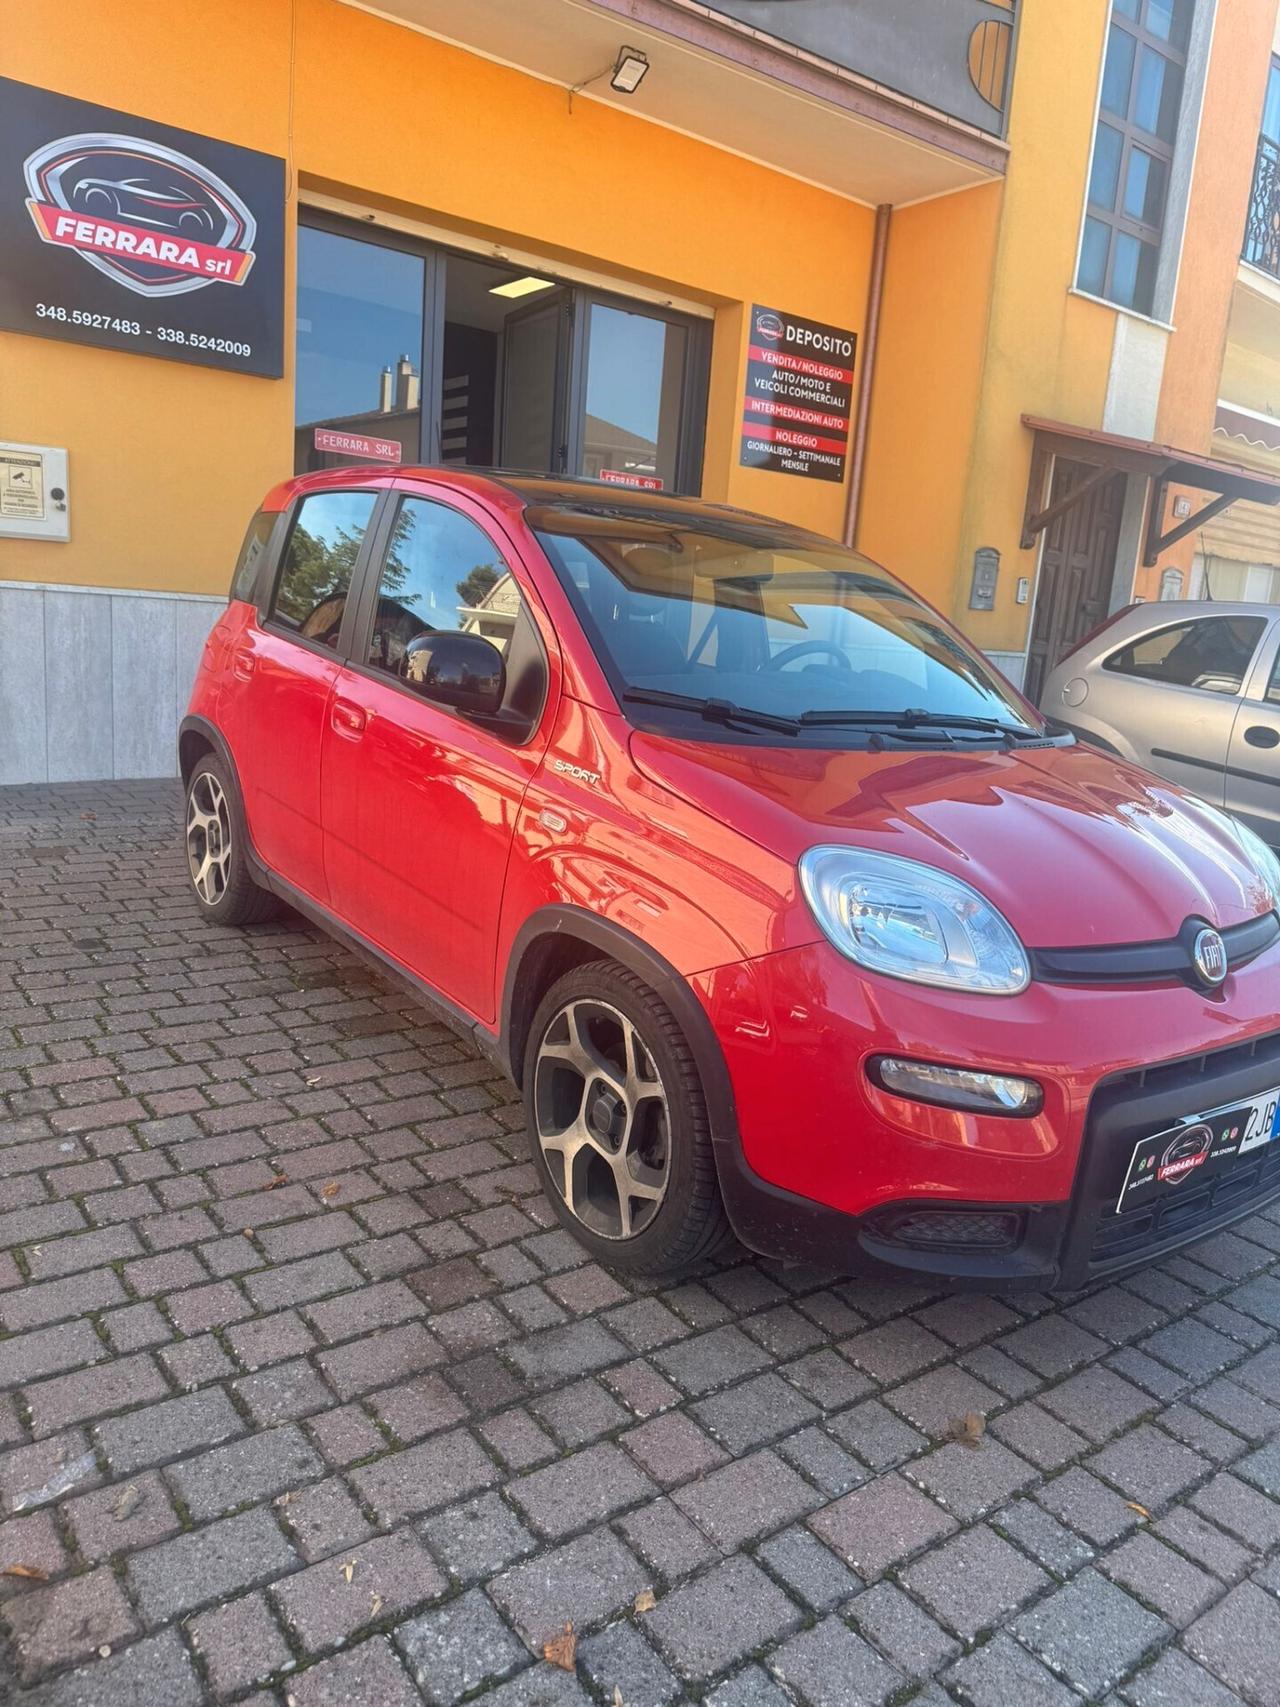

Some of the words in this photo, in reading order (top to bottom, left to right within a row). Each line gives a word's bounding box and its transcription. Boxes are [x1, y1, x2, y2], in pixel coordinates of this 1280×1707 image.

[55, 216, 200, 268] FERRARA
[205, 257, 232, 275] srl
[35, 303, 141, 336] 348.5927483
[157, 327, 251, 357] 338.5242009
[786, 325, 852, 357] DEPOSITO
[754, 378, 788, 395] VEICOLI
[788, 386, 845, 408] COMMERCIALI
[826, 383, 831, 392] E
[751, 400, 822, 425] INTERMEDIAZIONI
[823, 418, 843, 429] AUTO
[322, 434, 370, 452] FERRARA
[375, 443, 394, 456] SRL
[775, 431, 817, 448] NOLEGGIO
[747, 440, 793, 457] GIORNALIERO
[798, 451, 841, 466] SETTIMANALE
[781, 459, 809, 472] MENSILE
[553, 759, 601, 784] SPORT
[1203, 944, 1223, 970] FIAT
